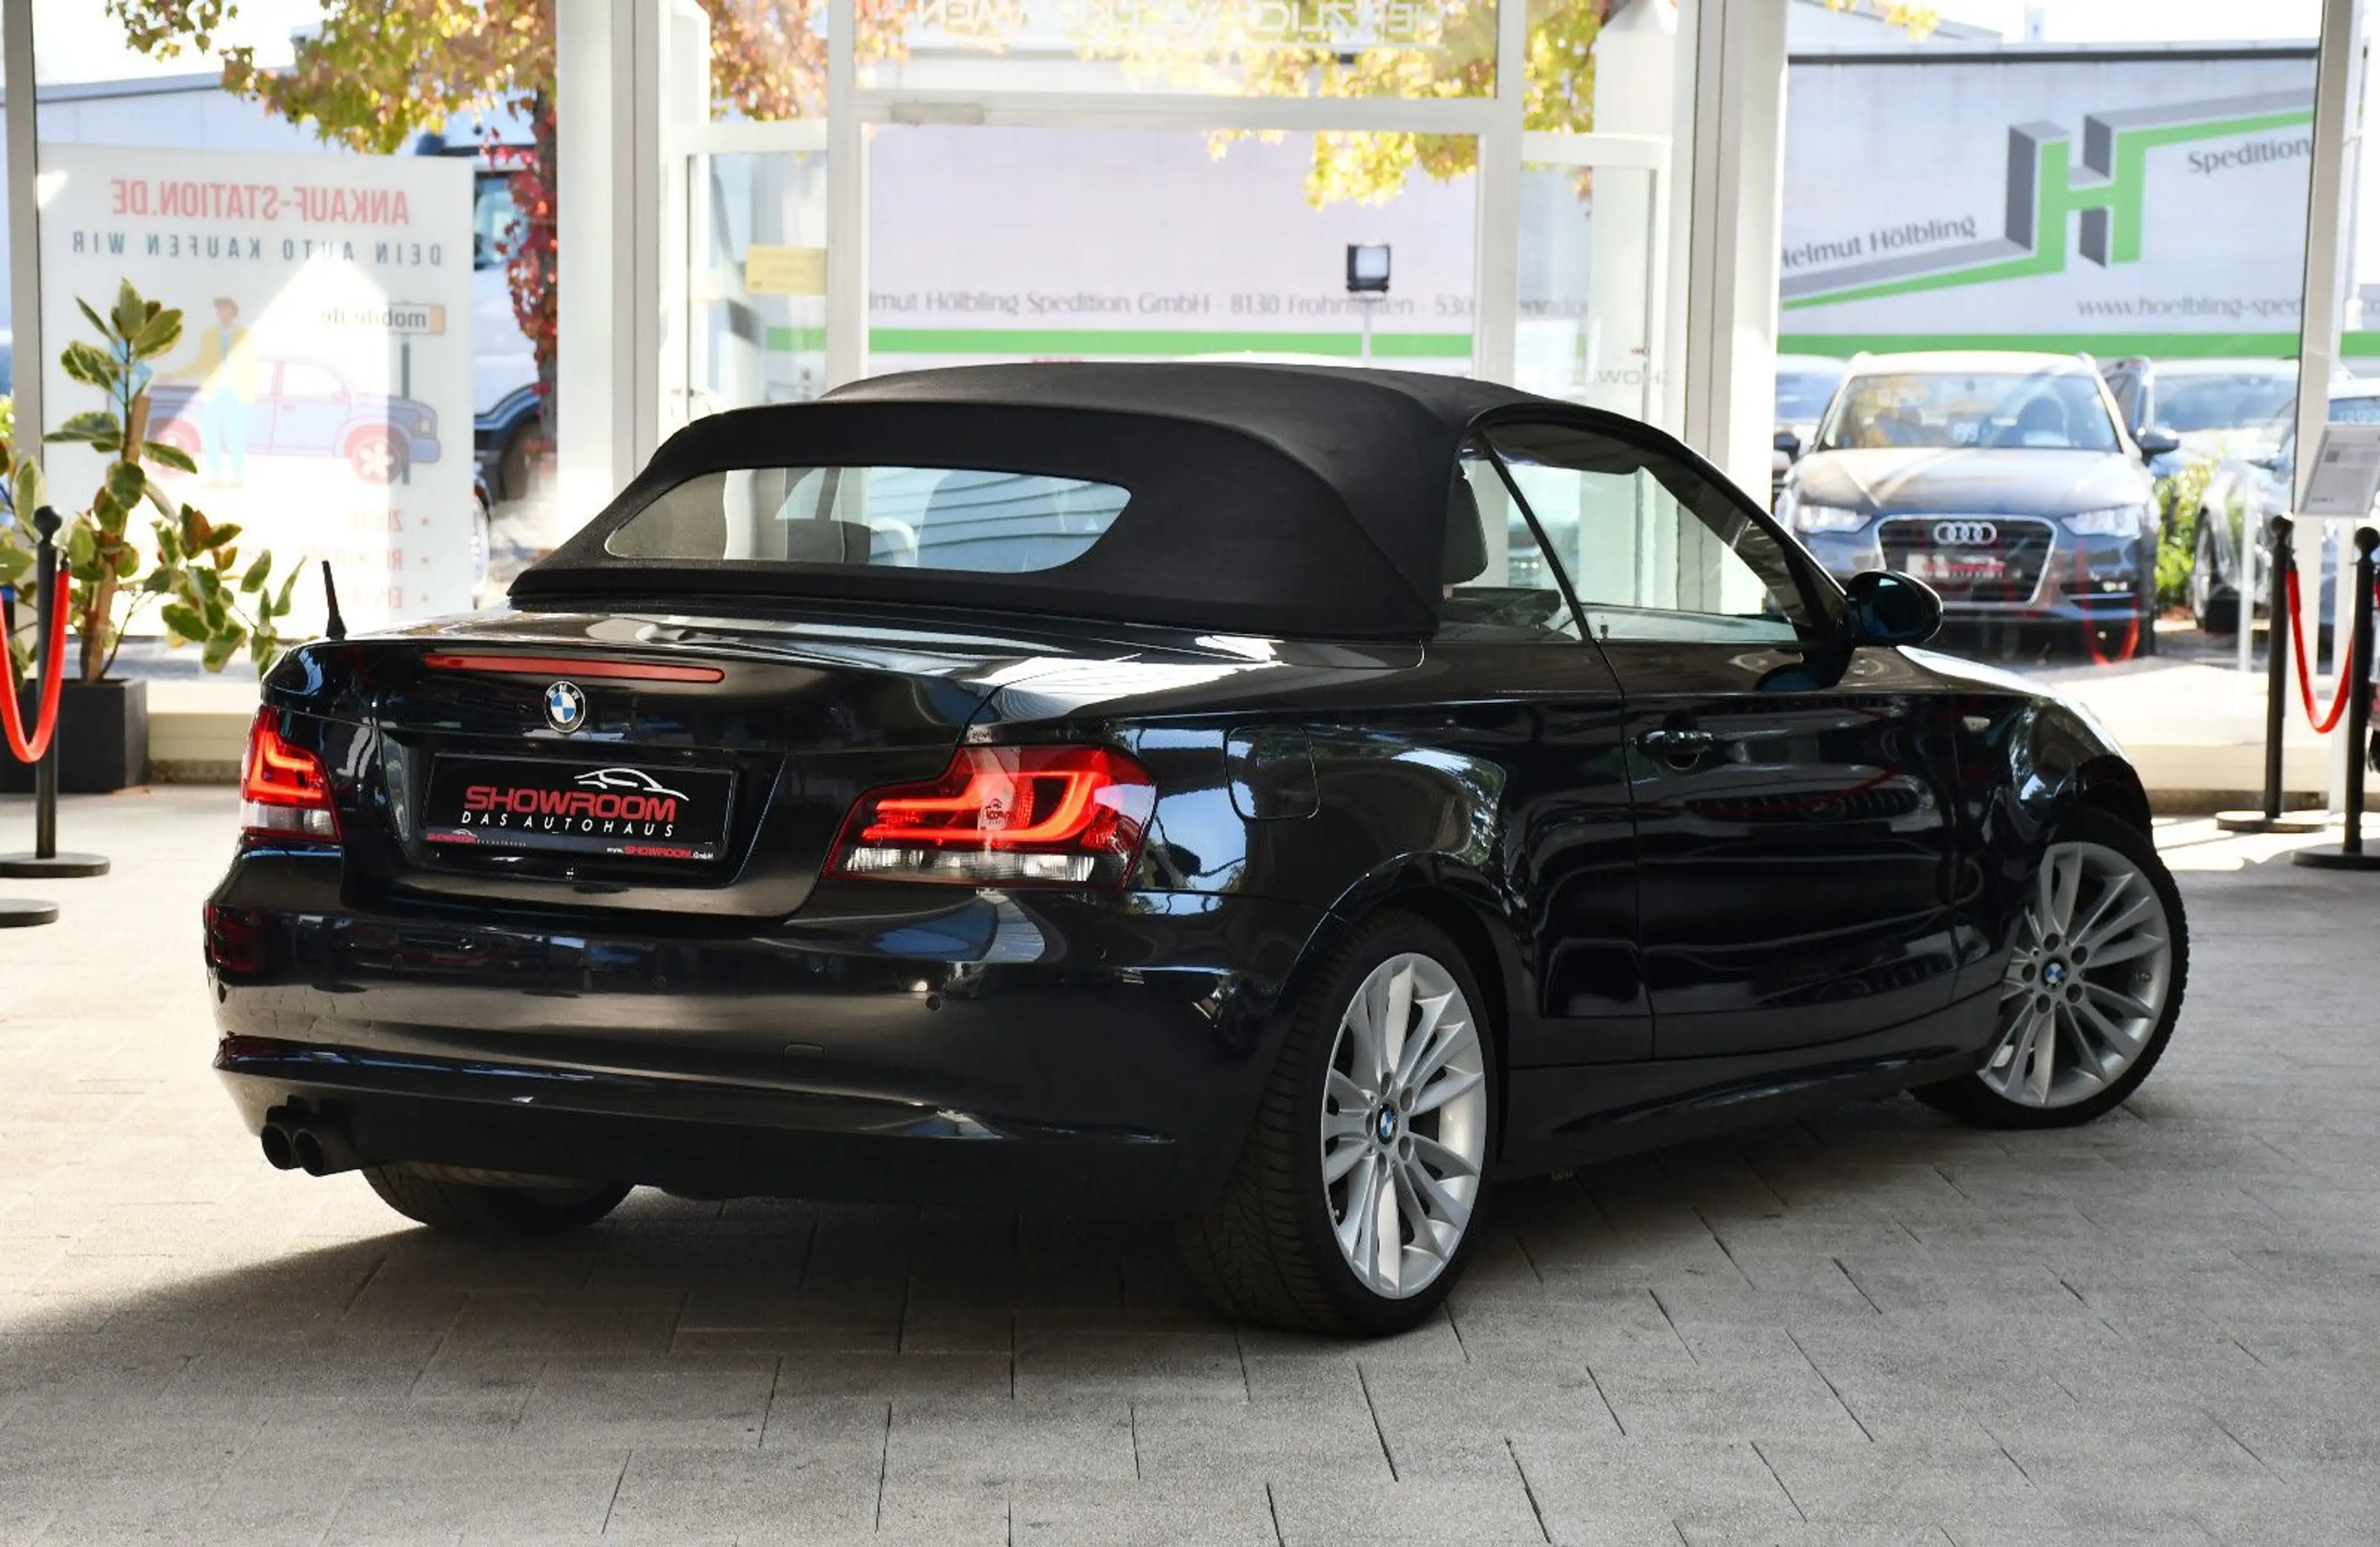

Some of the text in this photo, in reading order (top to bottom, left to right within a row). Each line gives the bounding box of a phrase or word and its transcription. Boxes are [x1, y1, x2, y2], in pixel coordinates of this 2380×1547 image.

[2188, 136, 2311, 174] Spedition
[1867, 215, 1977, 253] Hölbling
[926, 290, 1020, 315] Hölbling
[1027, 292, 1131, 315] Spedition
[1137, 293, 1210, 314] GmbH
[1230, 293, 1280, 315] 8130
[465, 785, 677, 822] SHOWROOM
[461, 811, 674, 837] DAS AUTOHAUS
